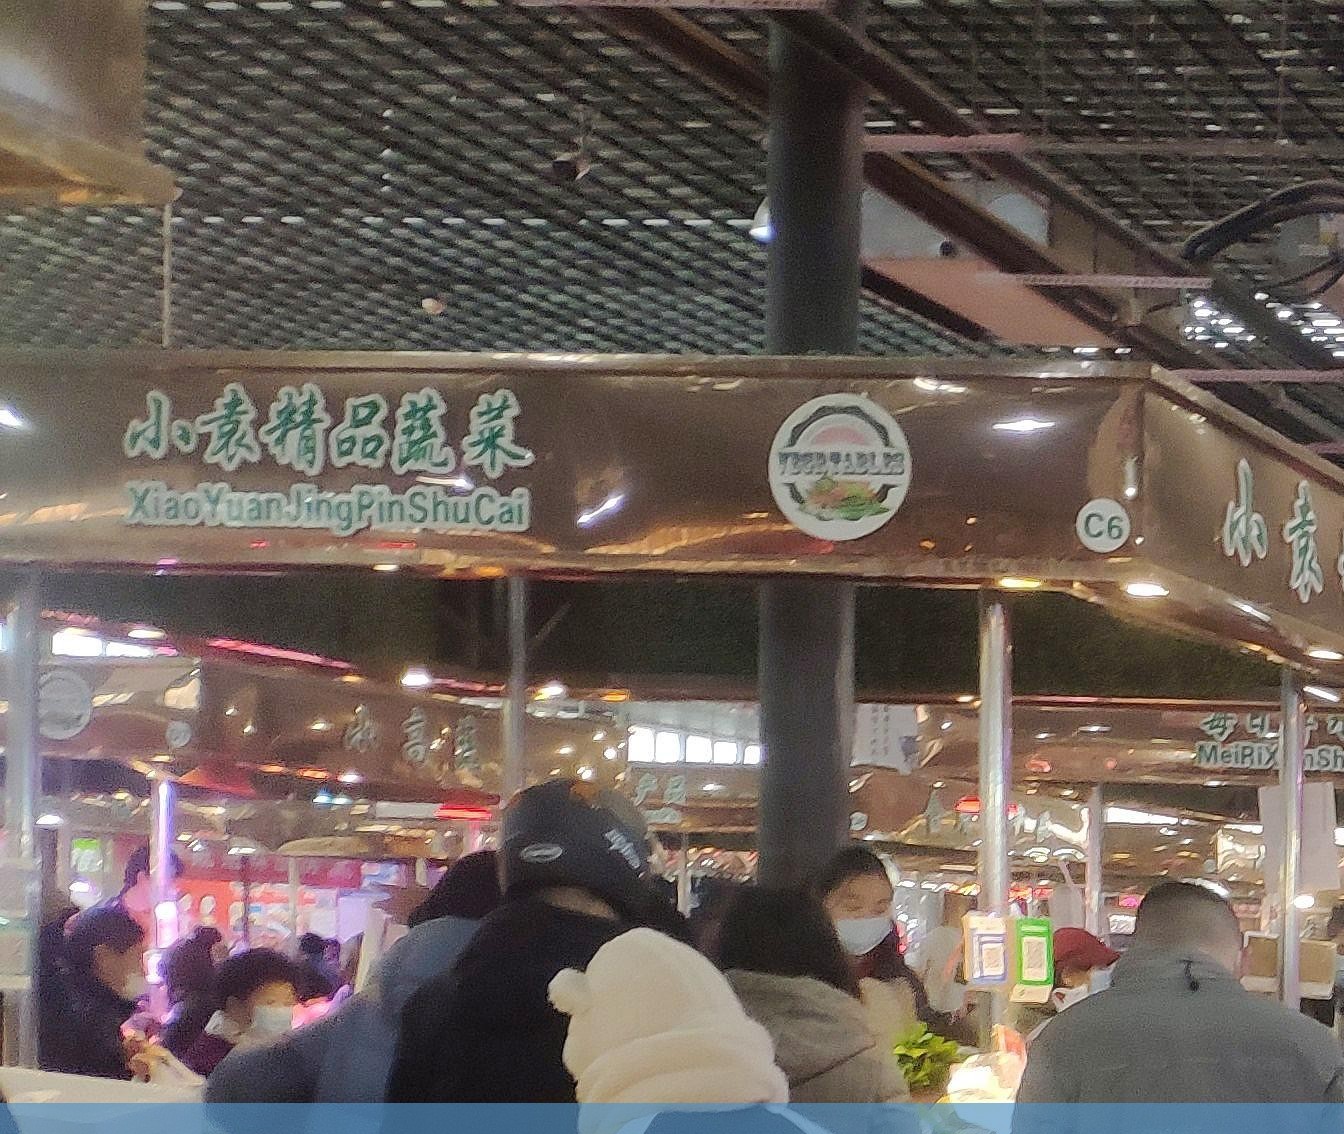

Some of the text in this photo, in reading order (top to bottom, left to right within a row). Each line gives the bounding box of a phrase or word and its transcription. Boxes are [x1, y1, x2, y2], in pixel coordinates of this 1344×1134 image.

[125, 386, 534, 475] 小袁精品蔬菜
[127, 486, 528, 532] XiaoYuanJingPinShuCai
[1084, 513, 1124, 540] C6
